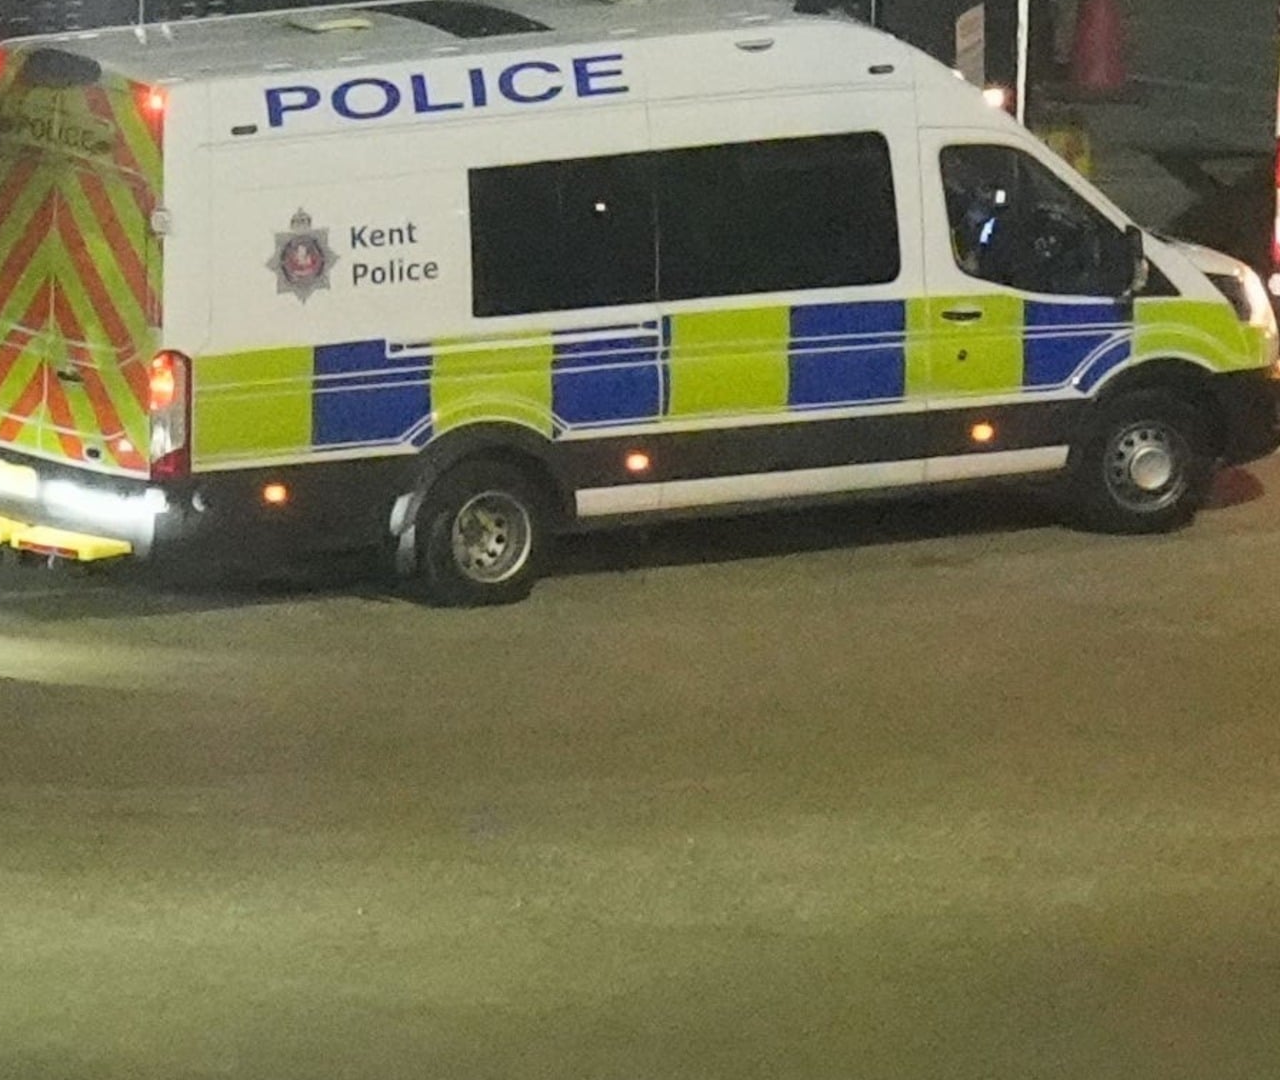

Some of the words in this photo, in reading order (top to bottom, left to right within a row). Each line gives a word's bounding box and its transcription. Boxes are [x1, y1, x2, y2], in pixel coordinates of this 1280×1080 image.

[264, 53, 630, 128] POLICE
[350, 222, 419, 249] Kent
[352, 258, 440, 286] Police
